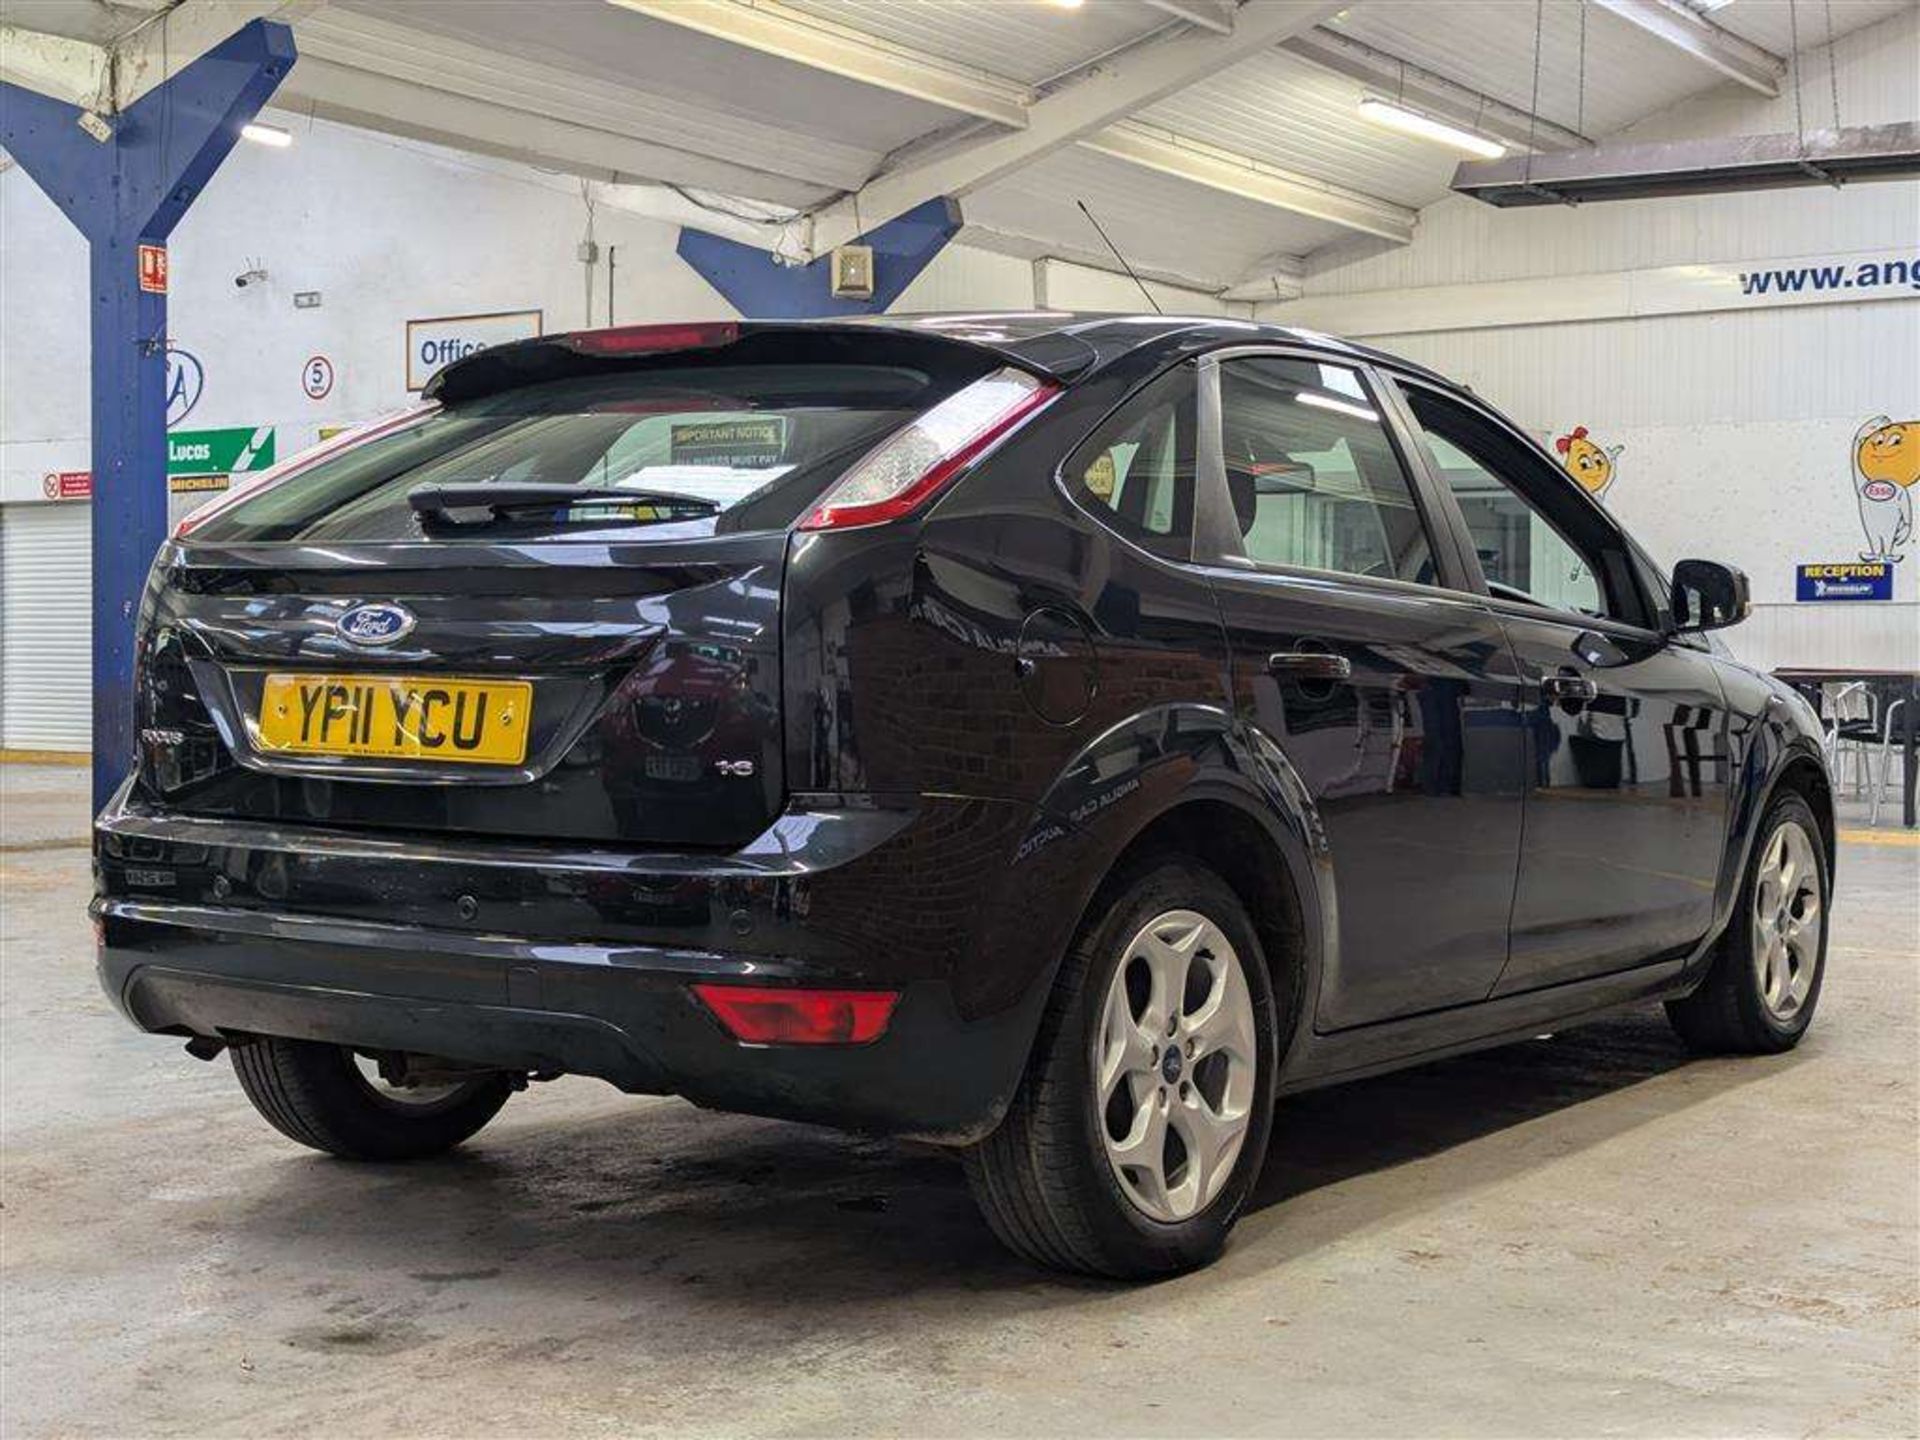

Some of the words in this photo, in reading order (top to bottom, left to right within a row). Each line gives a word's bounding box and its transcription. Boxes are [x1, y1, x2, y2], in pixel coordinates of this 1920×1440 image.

[312, 363, 324, 383] 5
[737, 423, 776, 439] NOTICE
[169, 441, 210, 461] Lucas
[759, 454, 777, 464] PAY
[1805, 565, 1884, 578] RECEPTION
[350, 610, 393, 636] Ford
[300, 685, 374, 744] YP11
[390, 687, 488, 750] YCU
